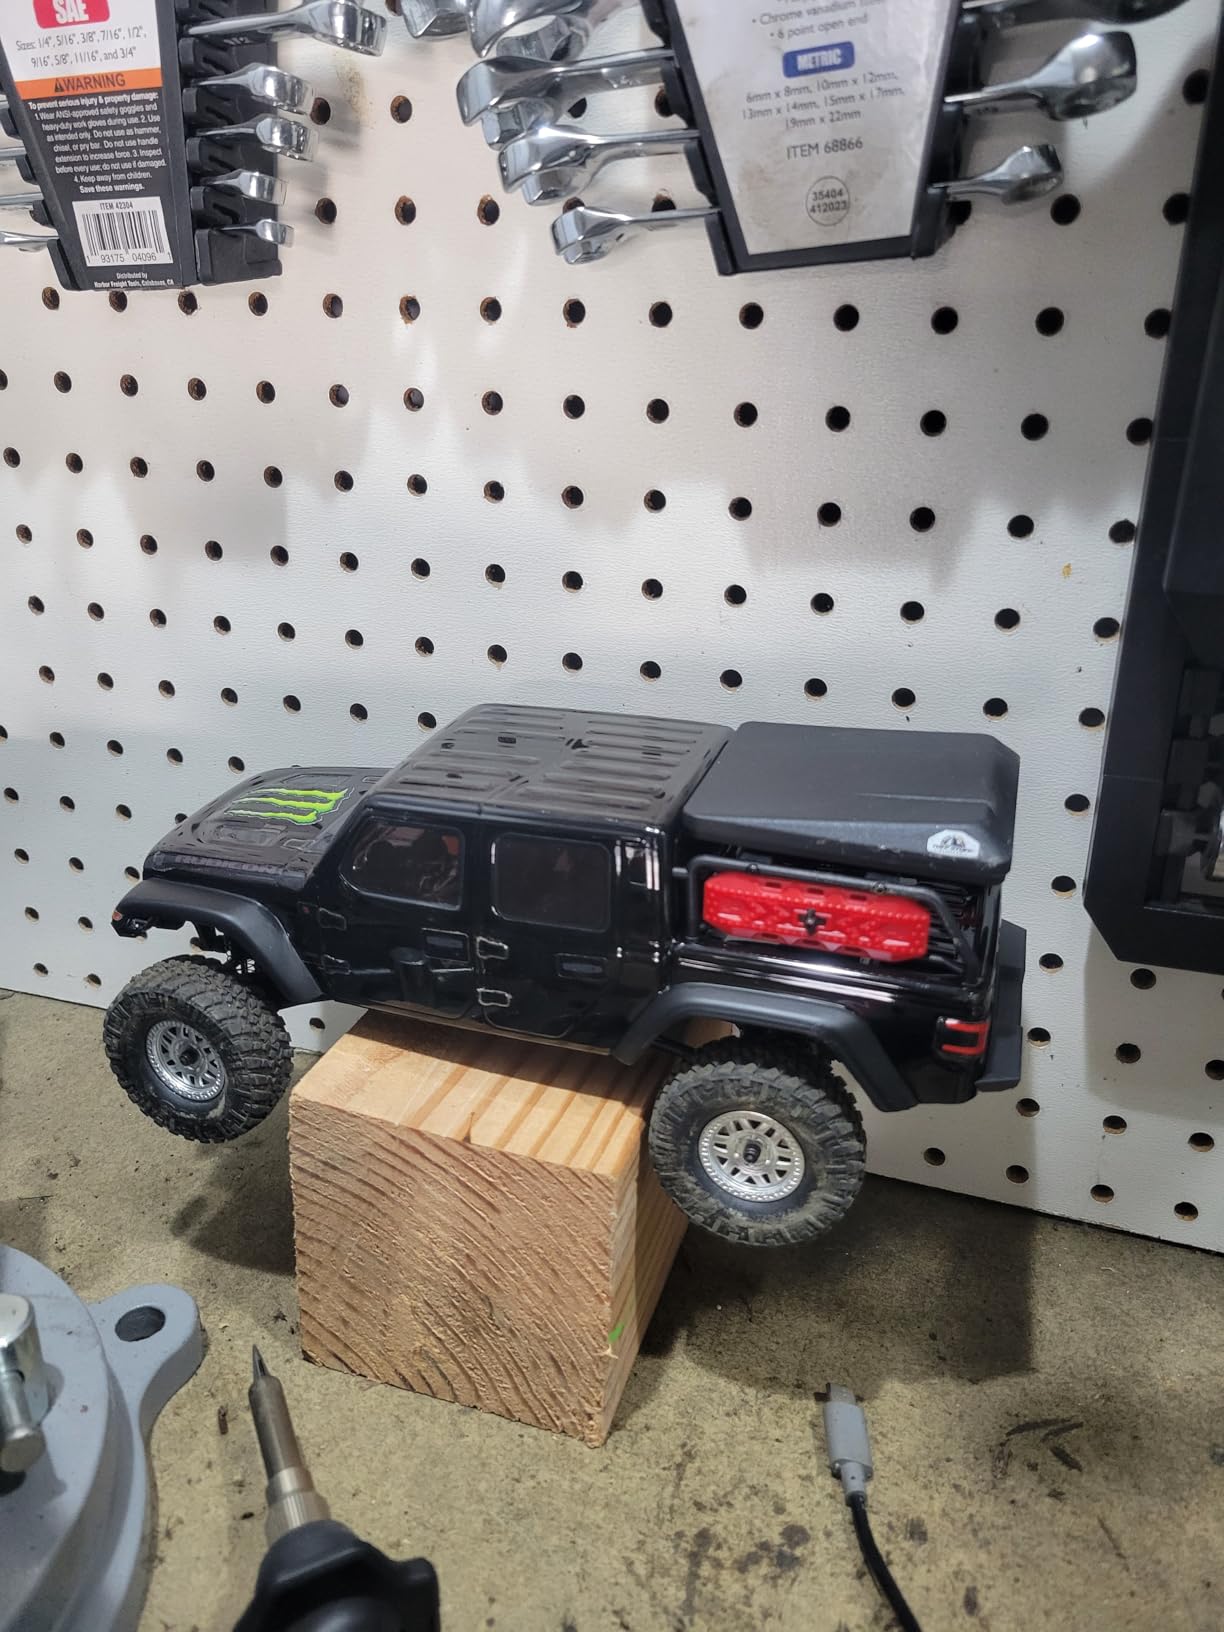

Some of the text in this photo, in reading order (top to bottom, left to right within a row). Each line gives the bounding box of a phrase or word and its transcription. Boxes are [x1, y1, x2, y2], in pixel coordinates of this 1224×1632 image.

[52, 0, 90, 24] SAE
[788, 25, 814, 40] point
[818, 20, 844, 34] open
[848, 12, 868, 26] end
[104, 49, 118, 60] and
[120, 46, 136, 58] 3/4"
[64, 73, 126, 92] WARNING
[746, 91, 771, 104] 6mm
[817, 80, 848, 92] 10mm
[28, 102, 36, 110] To
[100, 106, 118, 116] safety
[145, 102, 158, 111] and
[73, 120, 87, 128] work
[88, 118, 106, 128] gloves
[107, 116, 127, 126] during
[148, 114, 160, 122] Use
[46, 134, 54, 142] as
[93, 129, 102, 138] Do
[103, 128, 114, 137] not
[114, 128, 125, 136] use
[80, 143, 90, 152] pry
[104, 140, 113, 148] Do
[114, 140, 124, 148] not
[125, 138, 136, 146] use
[138, 137, 158, 146] handle
[787, 136, 864, 160] ITEM 68866
[82, 153, 88, 161] to
[90, 151, 114, 160] increase
[132, 149, 139, 157] 3.
[140, 148, 162, 158] Inspect
[102, 162, 110, 170] do
[110, 161, 120, 170] not
[121, 160, 132, 169] use
[80, 175, 96, 184] Keep
[96, 174, 112, 182] away
[112, 172, 126, 180] from
[80, 182, 145, 194] Save these warnings.
[100, 201, 134, 210] ITEM 42304
[100, 254, 125, 264] 93175
[132, 252, 157, 262] 04096
